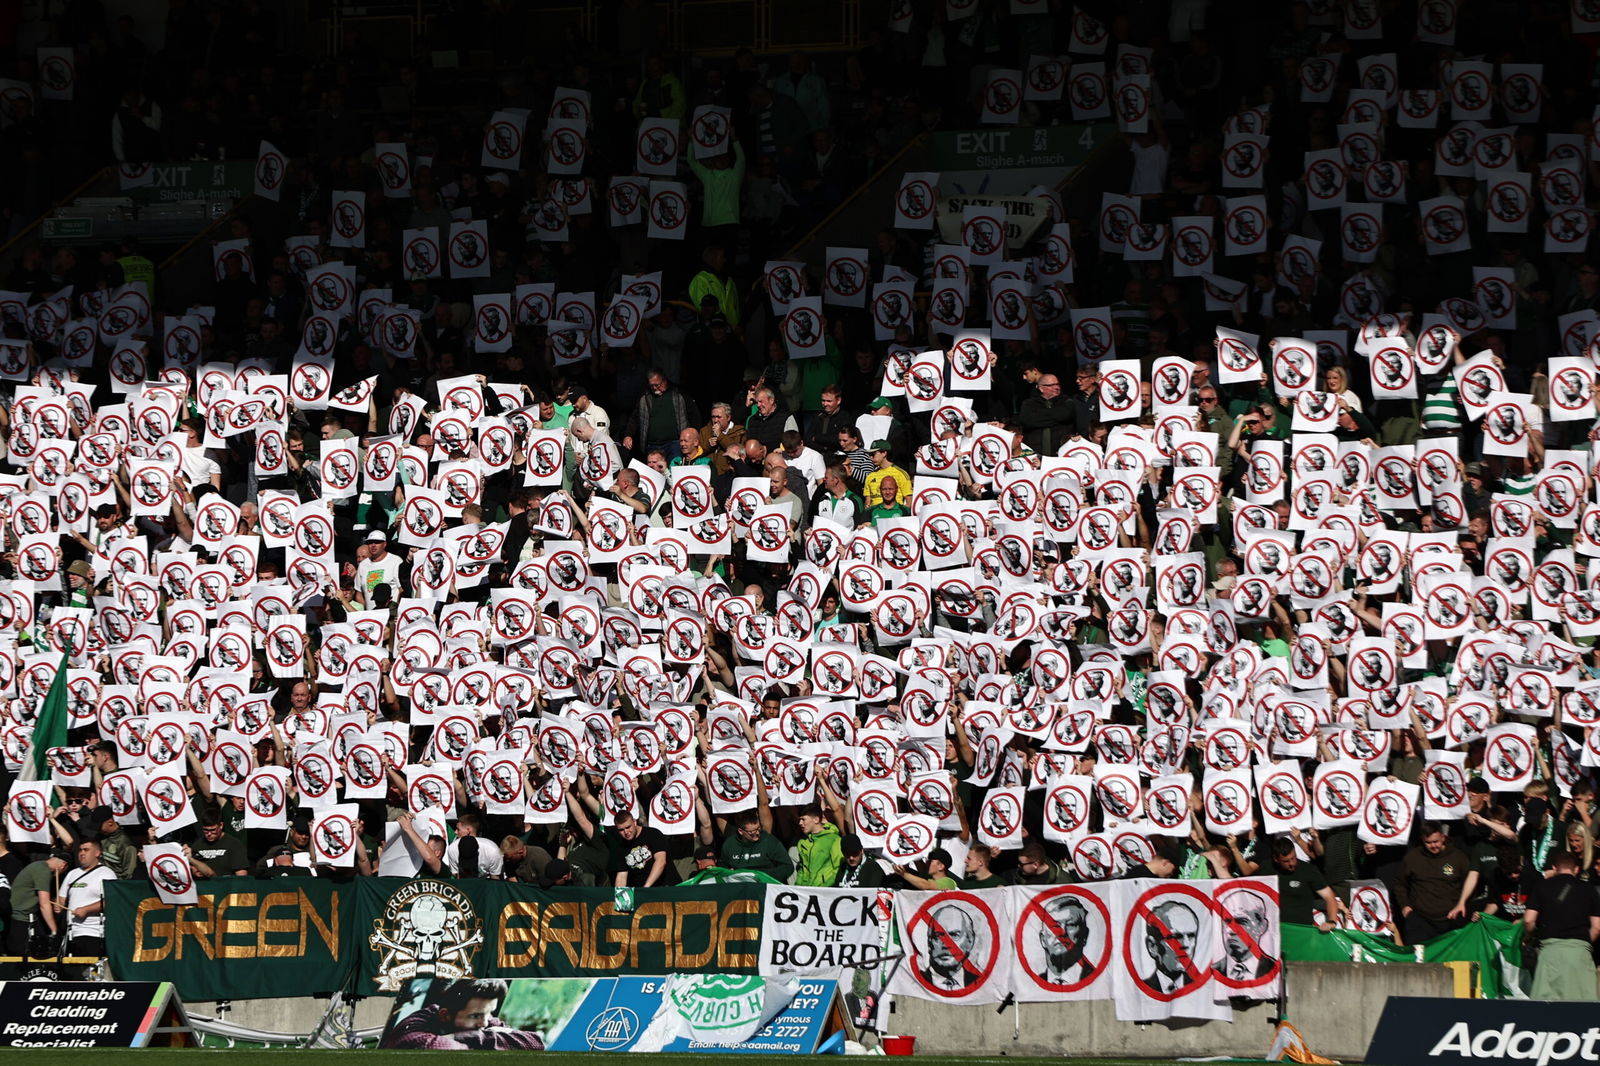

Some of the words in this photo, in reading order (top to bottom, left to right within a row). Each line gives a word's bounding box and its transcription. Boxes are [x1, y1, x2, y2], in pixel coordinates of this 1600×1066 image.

[957, 132, 1010, 153] EXIT
[1078, 127, 1094, 149] 4
[975, 154, 1014, 168] Slighe
[1016, 153, 1065, 166] A-mach
[155, 166, 193, 187] XIT
[386, 884, 419, 920] GREEN
[421, 881, 474, 921] BRIGADE
[774, 892, 880, 927] SACK
[133, 887, 339, 962] GREEN
[498, 900, 759, 969] BRIGADE
[814, 929, 844, 942] THE
[770, 940, 880, 970] BOARD
[28, 988, 125, 1000] Flammable
[641, 982, 655, 993] IS
[789, 998, 819, 1009] EY?
[30, 1005, 108, 1020] Cladding
[3, 1022, 118, 1036] Replacement
[605, 1020, 622, 1037] AA
[775, 1026, 808, 1037] 2727
[10, 1039, 96, 1048] Specialist
[688, 1040, 716, 1049] Email:
[1428, 1022, 1600, 1066] Adapt
